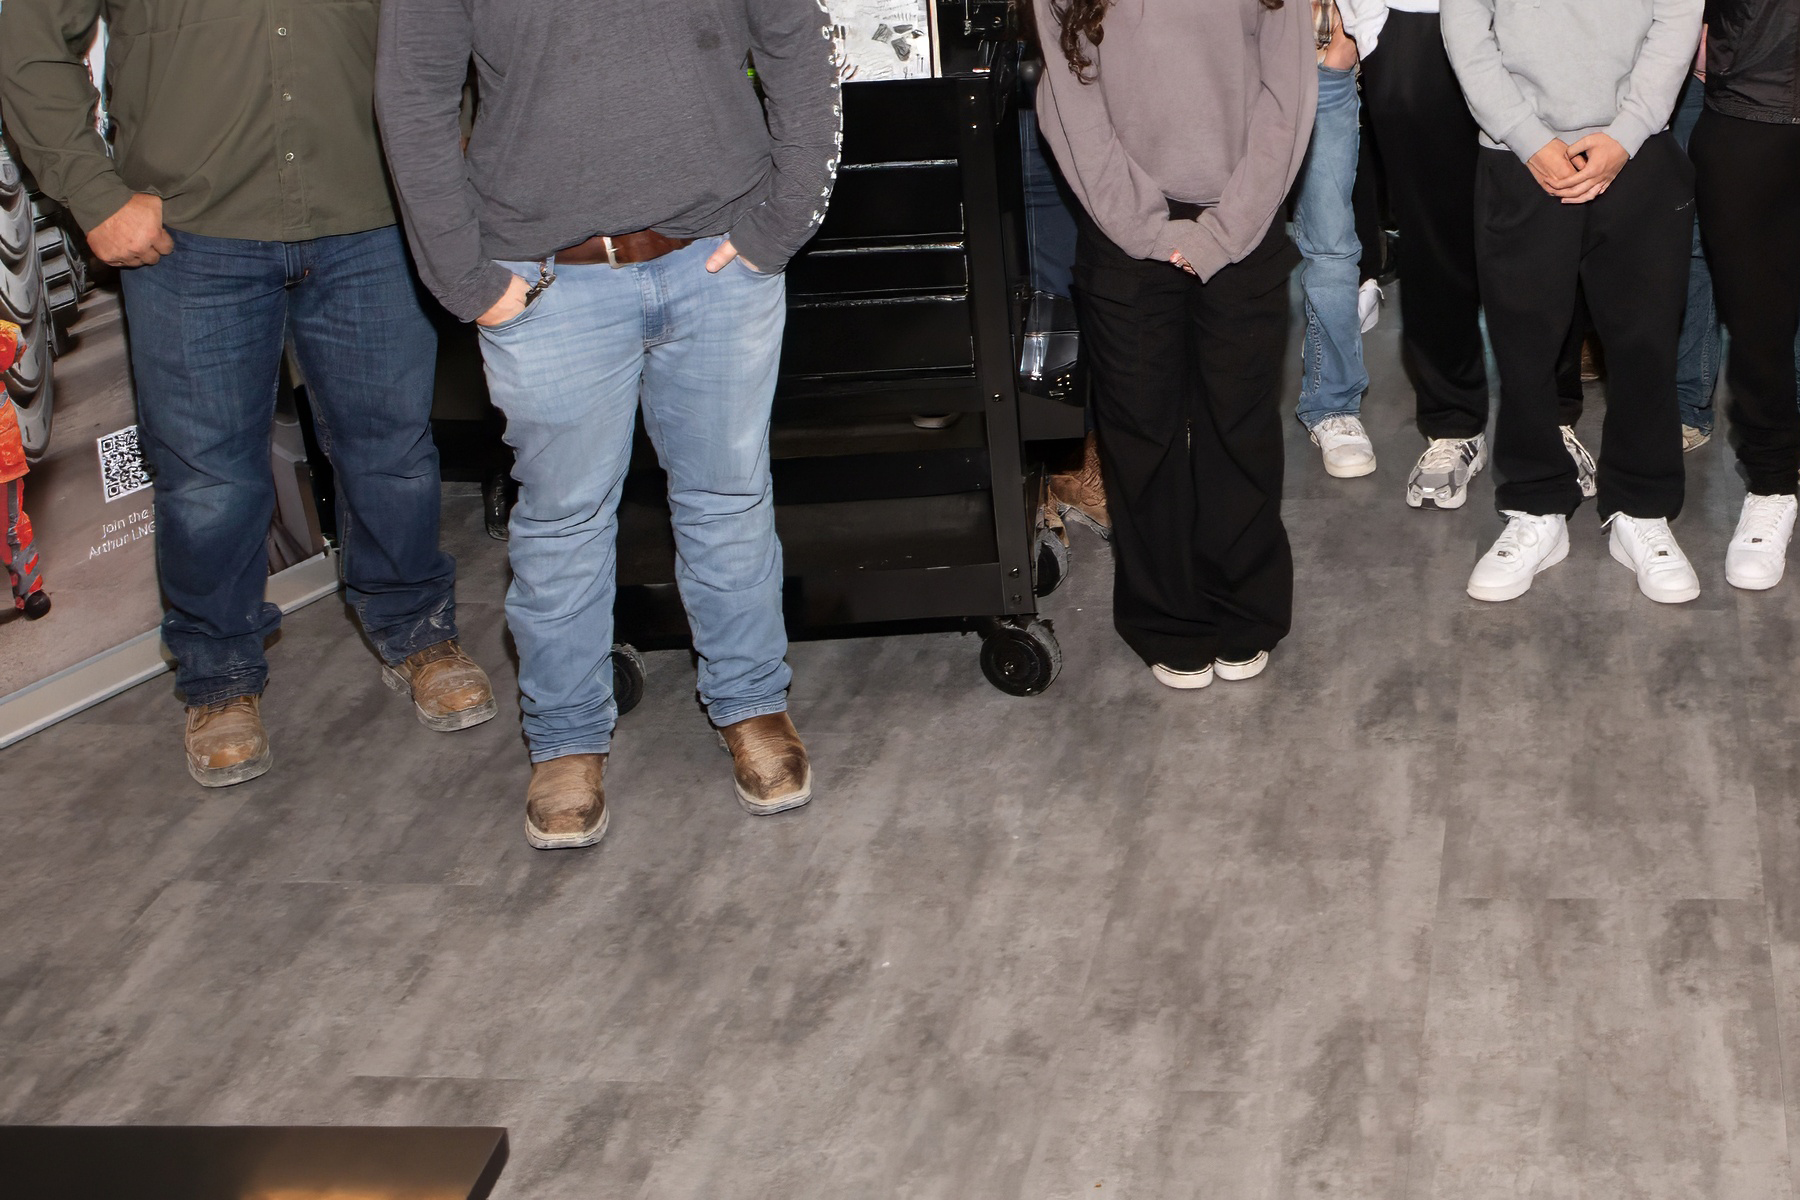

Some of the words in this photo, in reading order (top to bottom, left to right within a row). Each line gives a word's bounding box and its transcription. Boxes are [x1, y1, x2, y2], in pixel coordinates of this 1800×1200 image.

[102, 520, 126, 539] Join
[128, 508, 150, 525] the
[89, 534, 129, 560] Arthur
